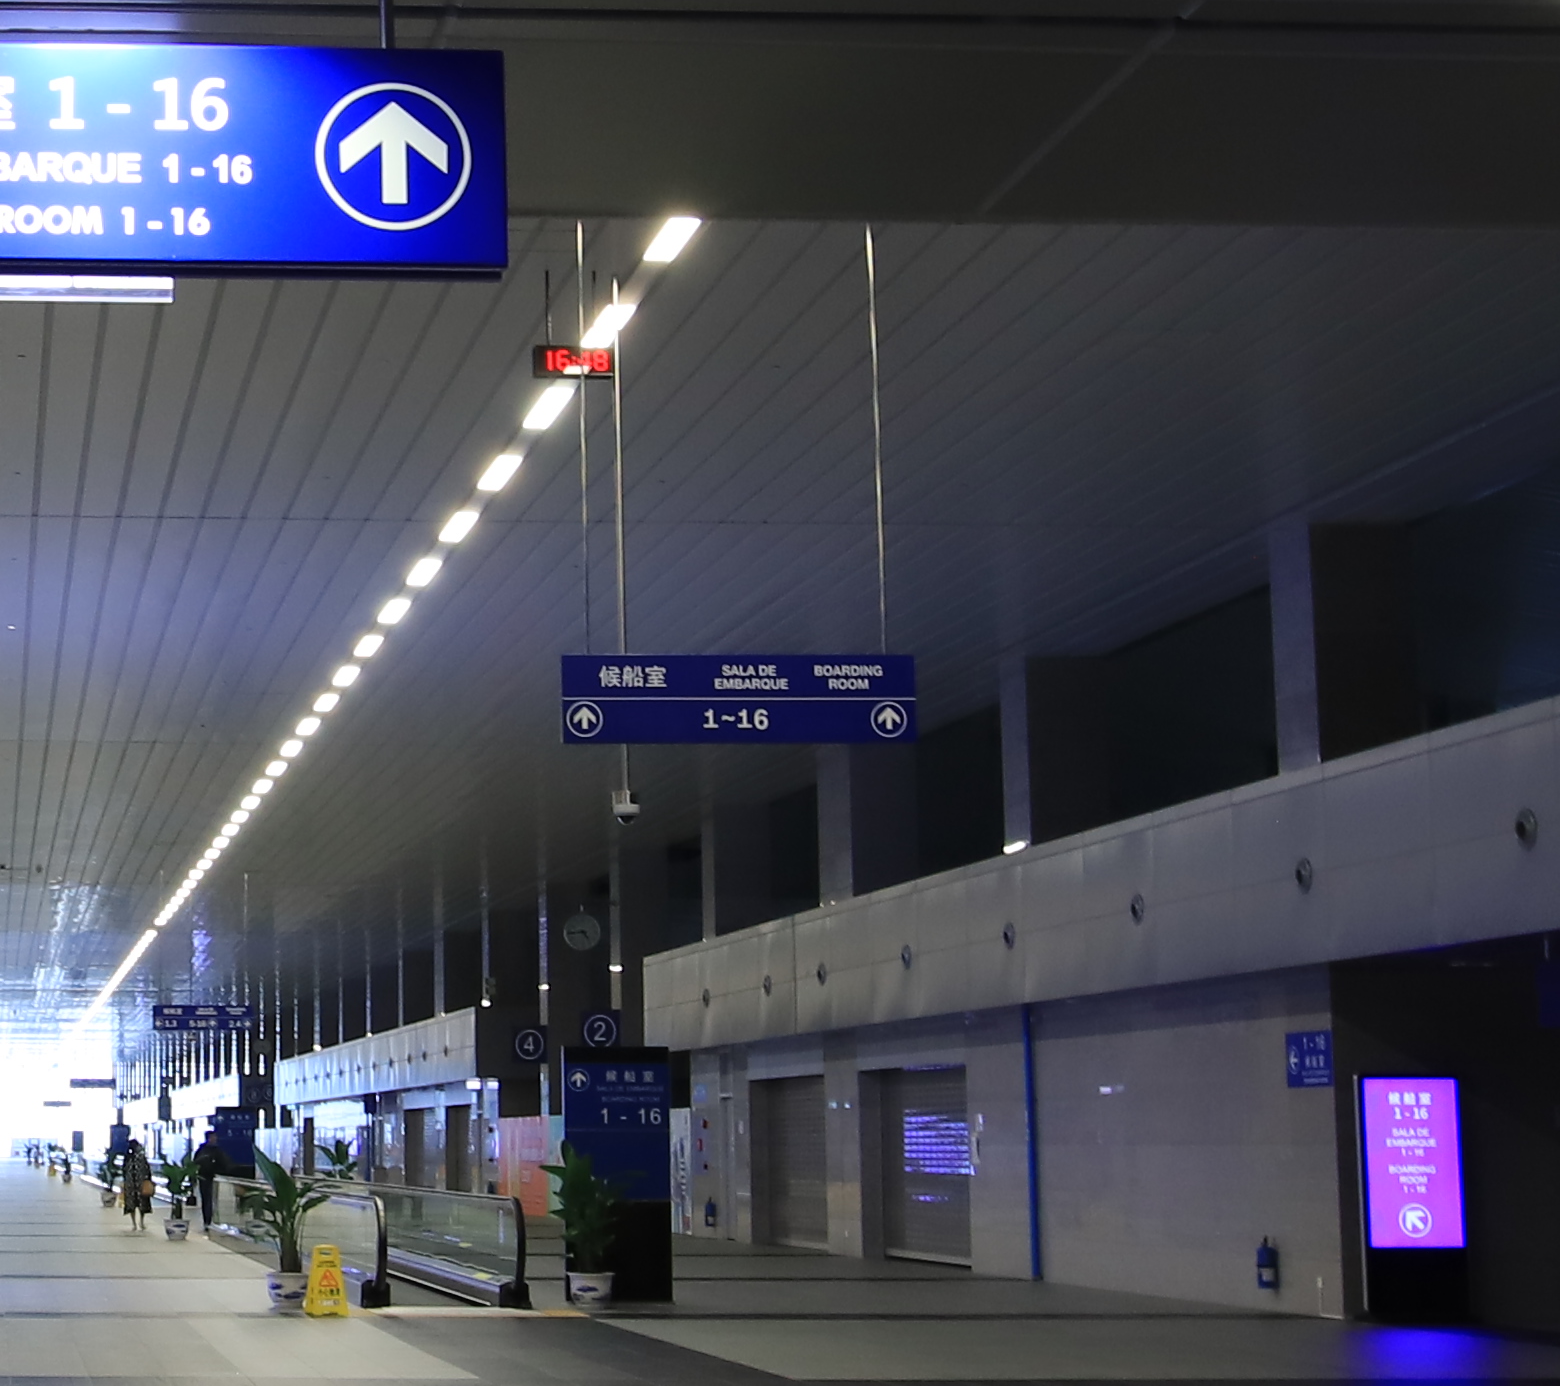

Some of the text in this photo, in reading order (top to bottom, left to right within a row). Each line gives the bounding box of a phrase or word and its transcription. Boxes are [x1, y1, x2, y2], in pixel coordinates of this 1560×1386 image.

[599, 665, 667, 688] 候船室
[721, 665, 777, 677] SALA DE
[813, 665, 883, 677] BOARDING
[714, 679, 789, 690] EMBARQUE
[828, 679, 870, 690] ROOM
[593, 1021, 606, 1041] 2
[523, 1036, 534, 1053] 4
